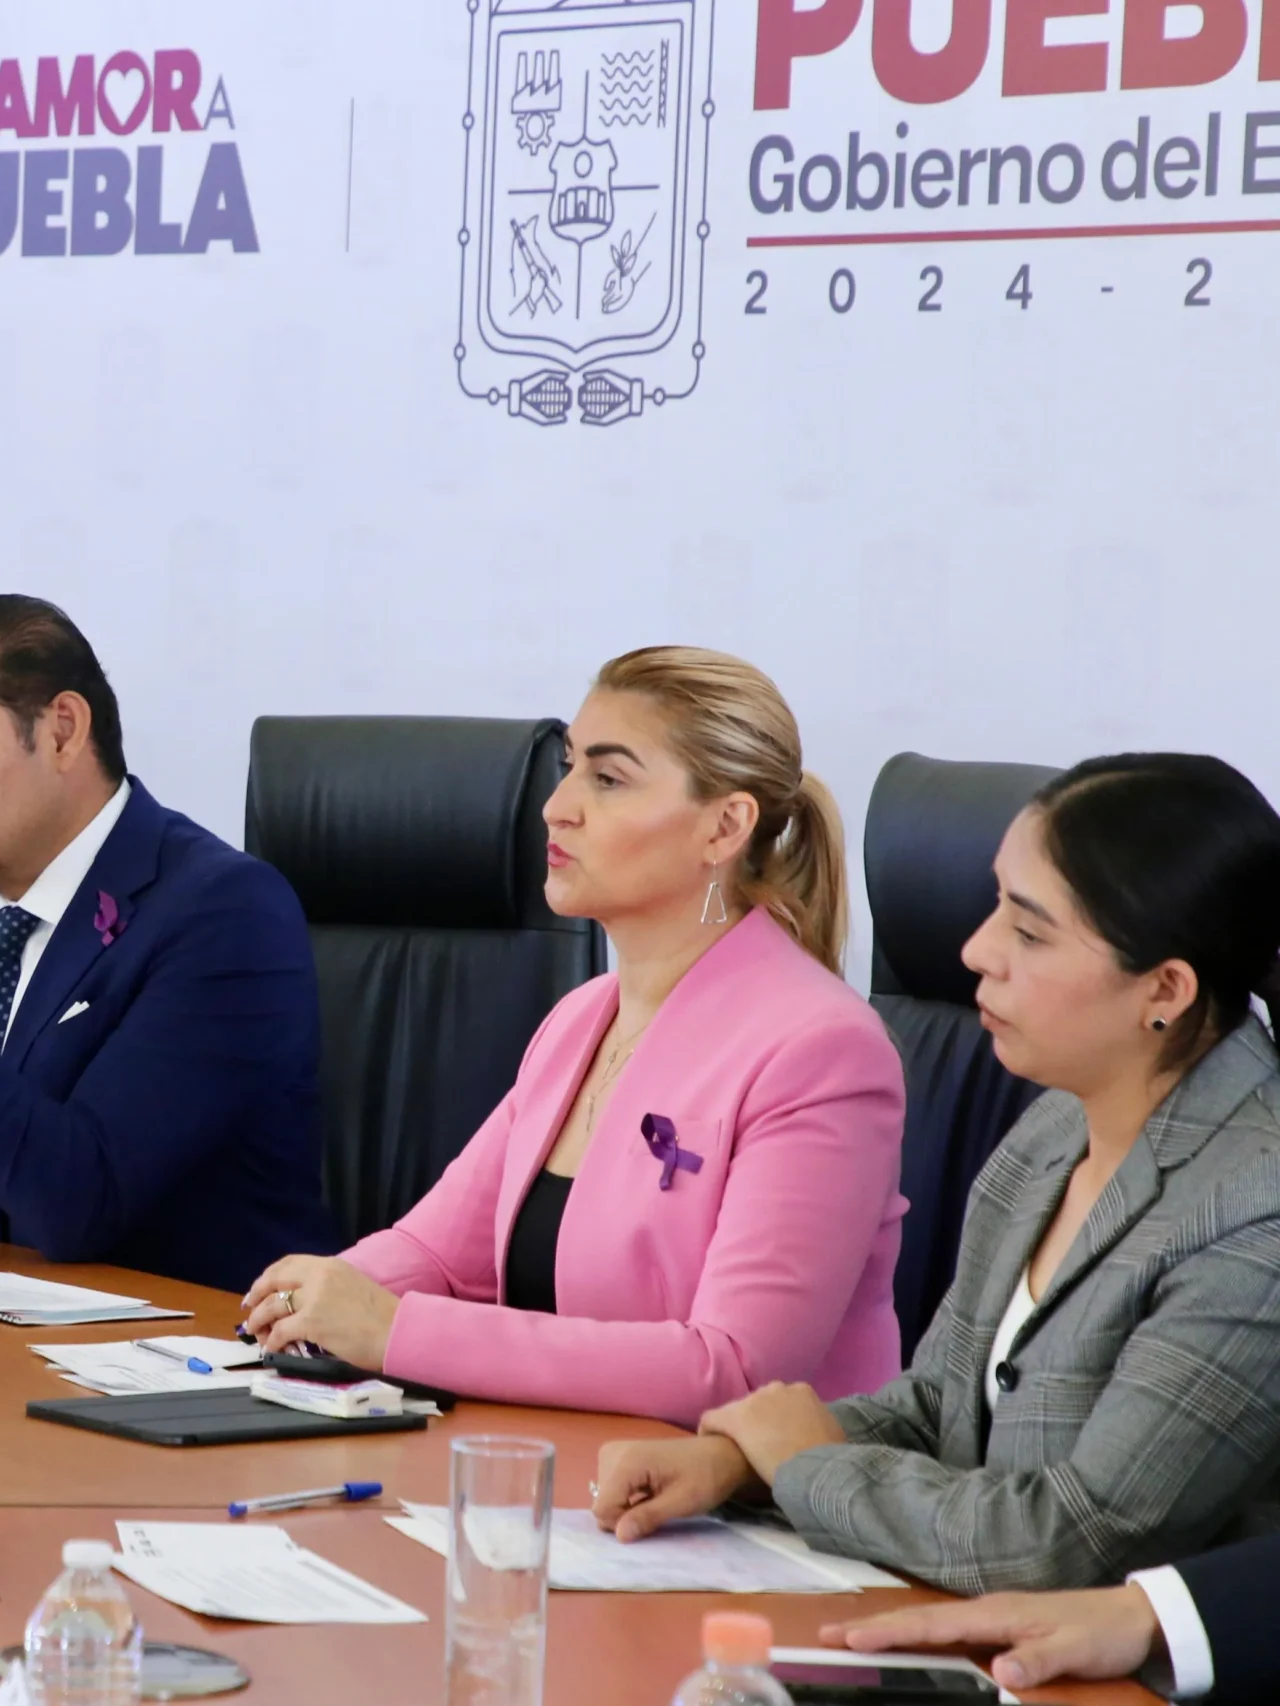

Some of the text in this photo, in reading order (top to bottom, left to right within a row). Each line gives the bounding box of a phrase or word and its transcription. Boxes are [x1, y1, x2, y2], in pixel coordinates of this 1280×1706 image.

[203, 73, 236, 130] A
[748, 121, 1085, 214] Gobierno
[1100, 111, 1221, 202] del
